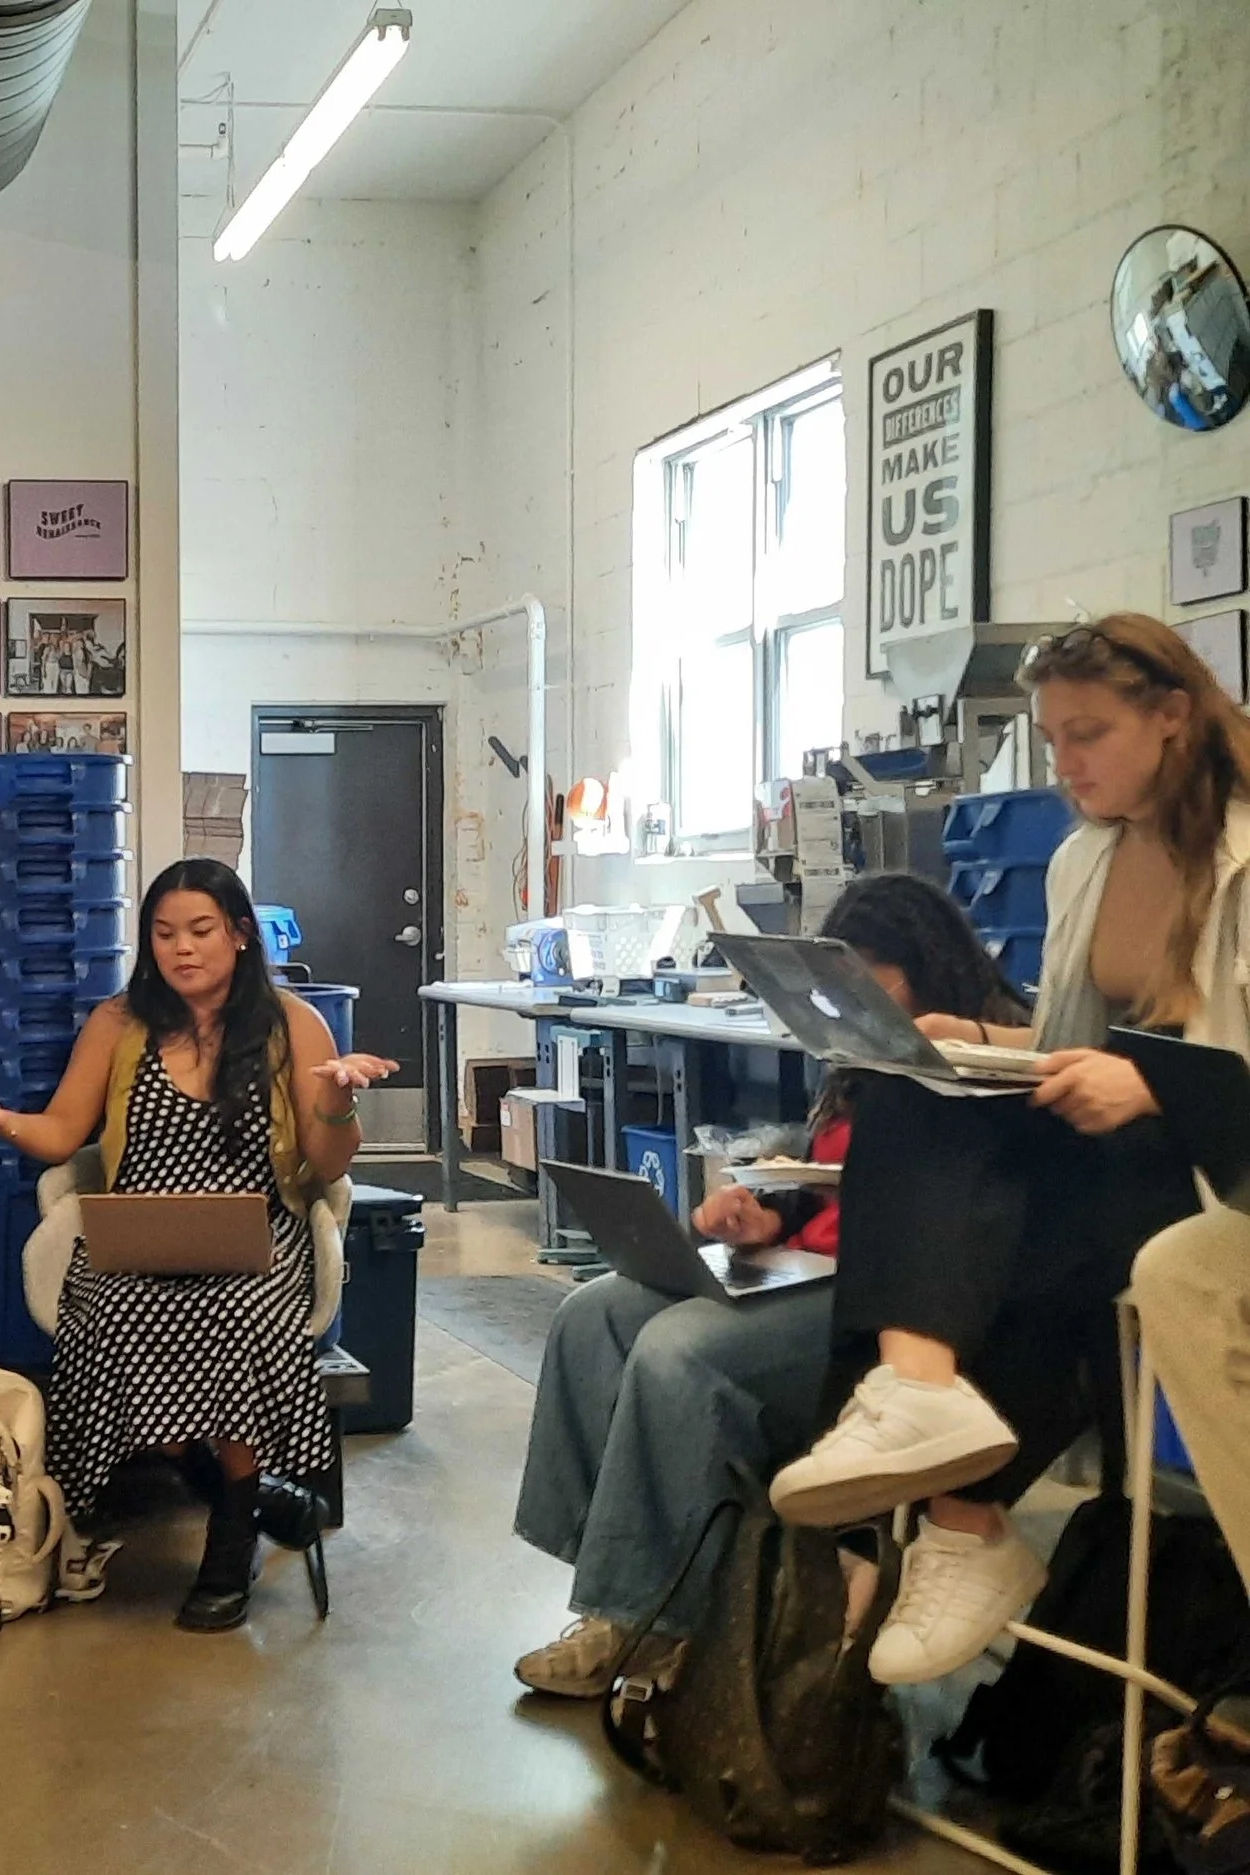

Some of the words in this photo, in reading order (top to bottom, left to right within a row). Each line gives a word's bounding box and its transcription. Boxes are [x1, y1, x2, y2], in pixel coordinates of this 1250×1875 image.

[882, 342, 964, 404] OUR
[885, 389, 960, 443] DIFFERENCES
[881, 433, 960, 485] MAKE
[40, 503, 85, 526] SWEET
[881, 475, 959, 547] US
[879, 541, 959, 634] DOPE
